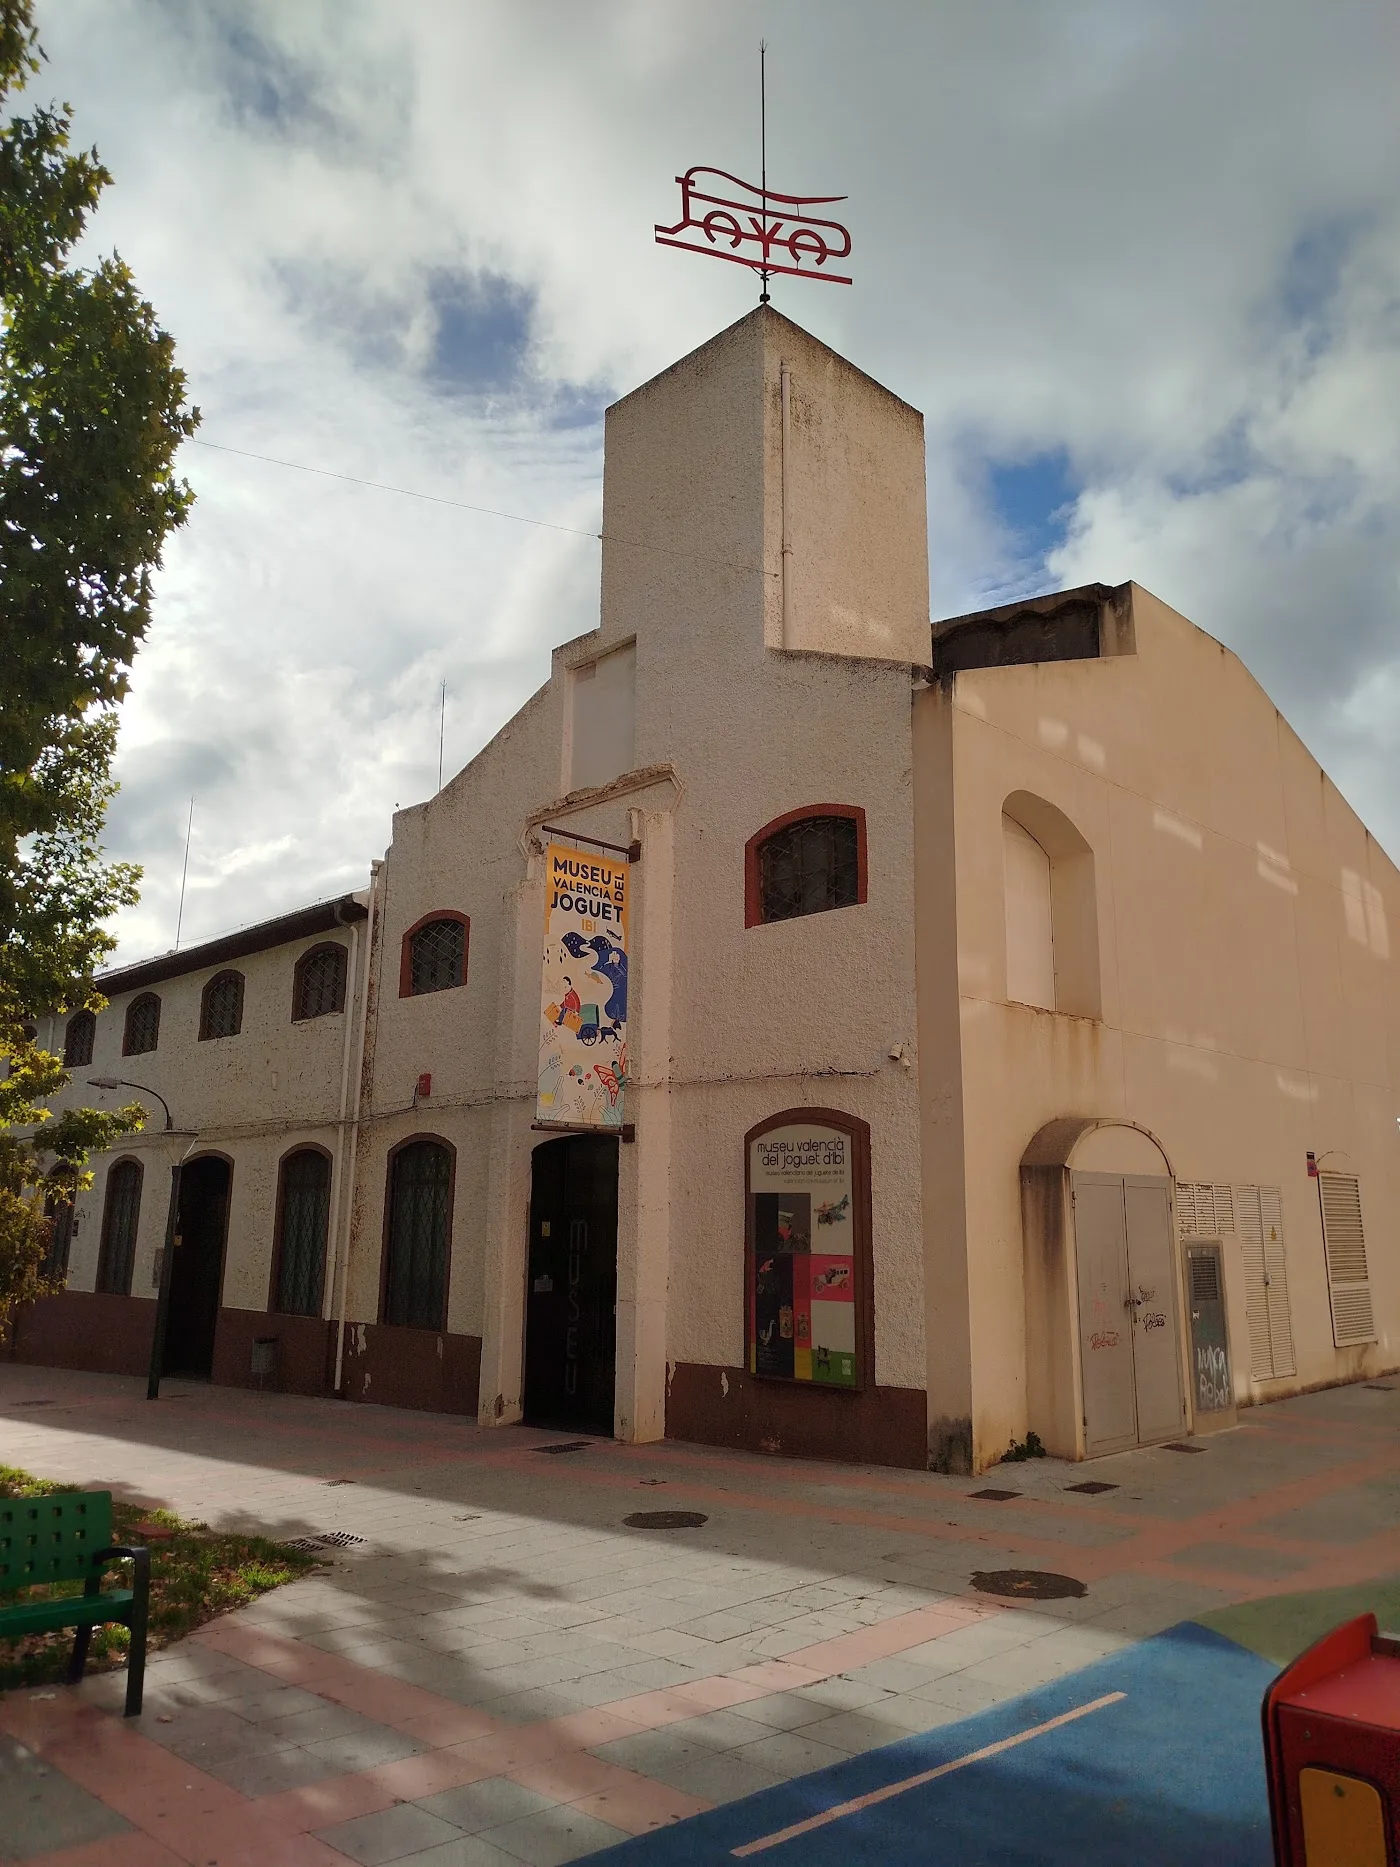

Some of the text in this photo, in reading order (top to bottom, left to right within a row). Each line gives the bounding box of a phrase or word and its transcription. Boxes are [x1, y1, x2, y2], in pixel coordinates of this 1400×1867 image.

[554, 856, 612, 885] MUSEU
[553, 876, 611, 901] VALENCIÀ
[614, 872, 625, 902] DEL
[550, 891, 624, 923] JOGUET
[581, 918, 597, 933] IBI
[757, 1136, 844, 1153] museu valencià
[762, 1152, 779, 1166] del
[781, 1151, 820, 1170] joguet
